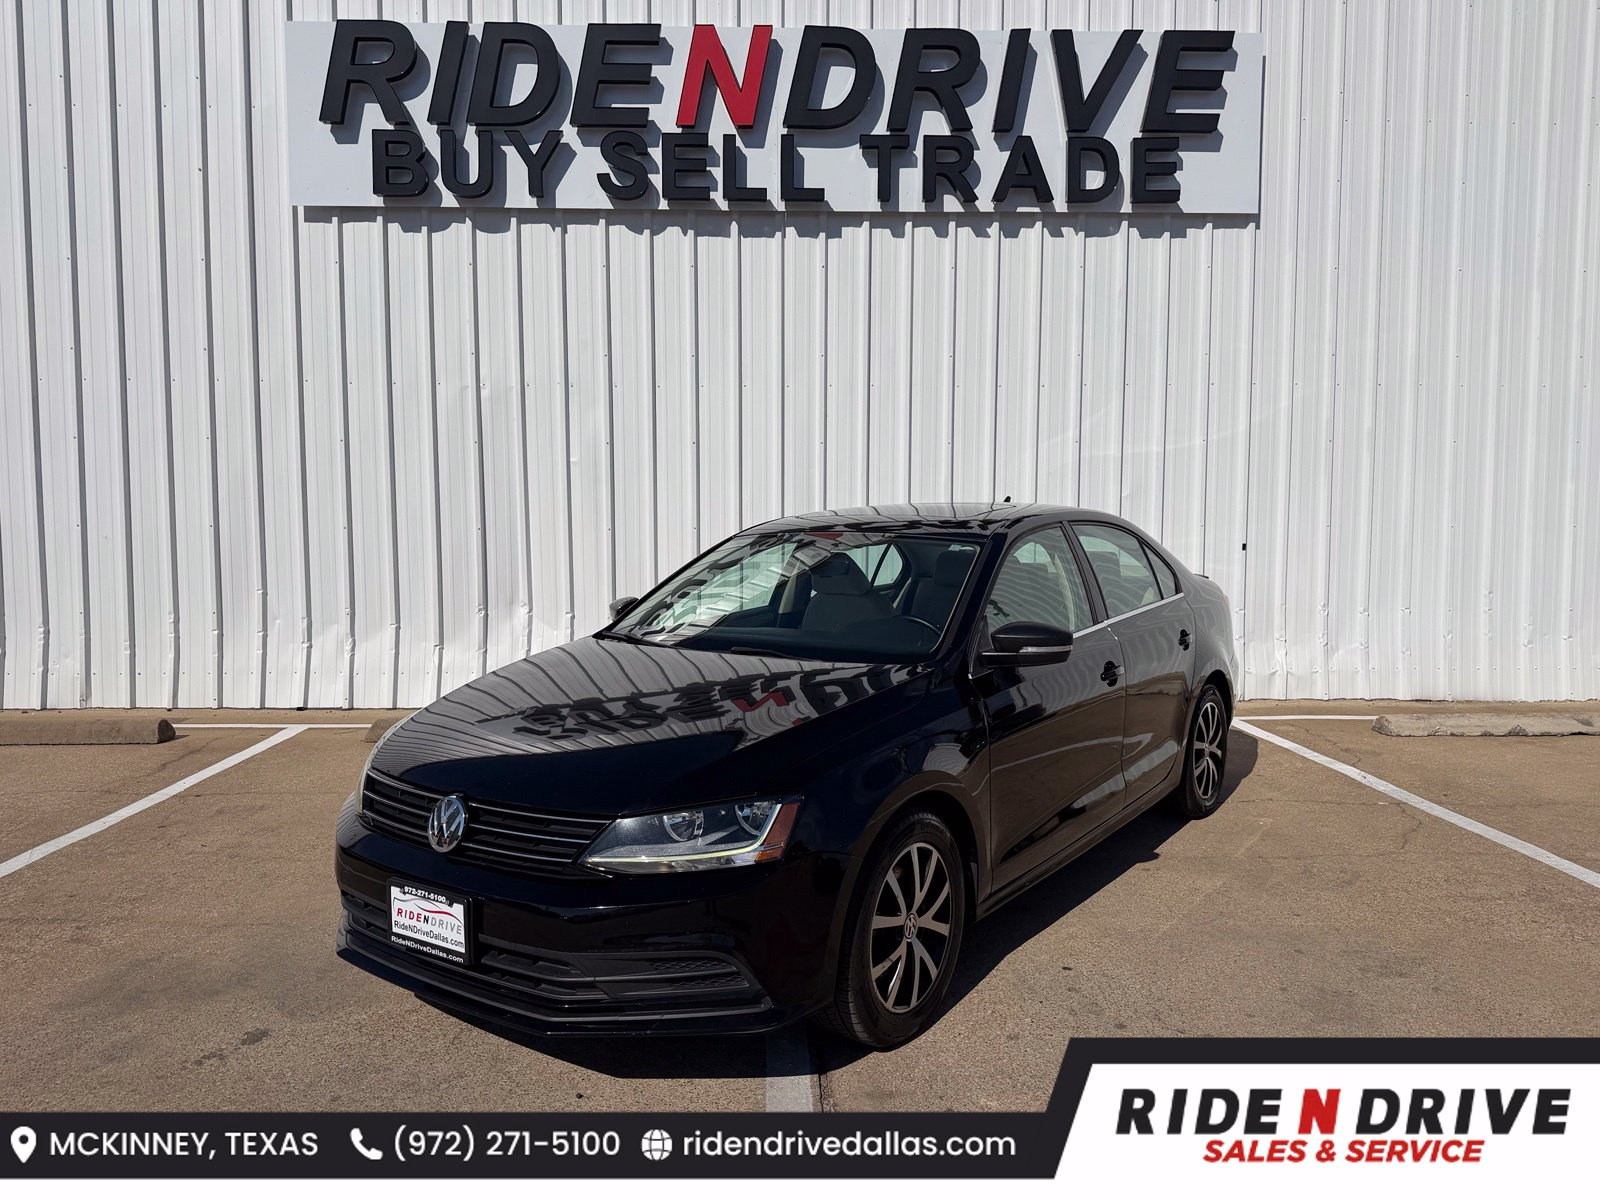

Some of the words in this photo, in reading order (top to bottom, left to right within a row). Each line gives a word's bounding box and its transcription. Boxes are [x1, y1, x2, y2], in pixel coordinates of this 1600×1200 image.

[372, 129, 564, 198] BUY
[597, 131, 825, 202] SELL
[859, 134, 1181, 204] TRADE
[404, 886, 447, 904] 972-271-5100
[393, 919, 465, 949] RideNDriveDallas.com
[396, 907, 463, 936] RIDENDRIVE
[391, 935, 464, 963] RideNDriveDallas.com
